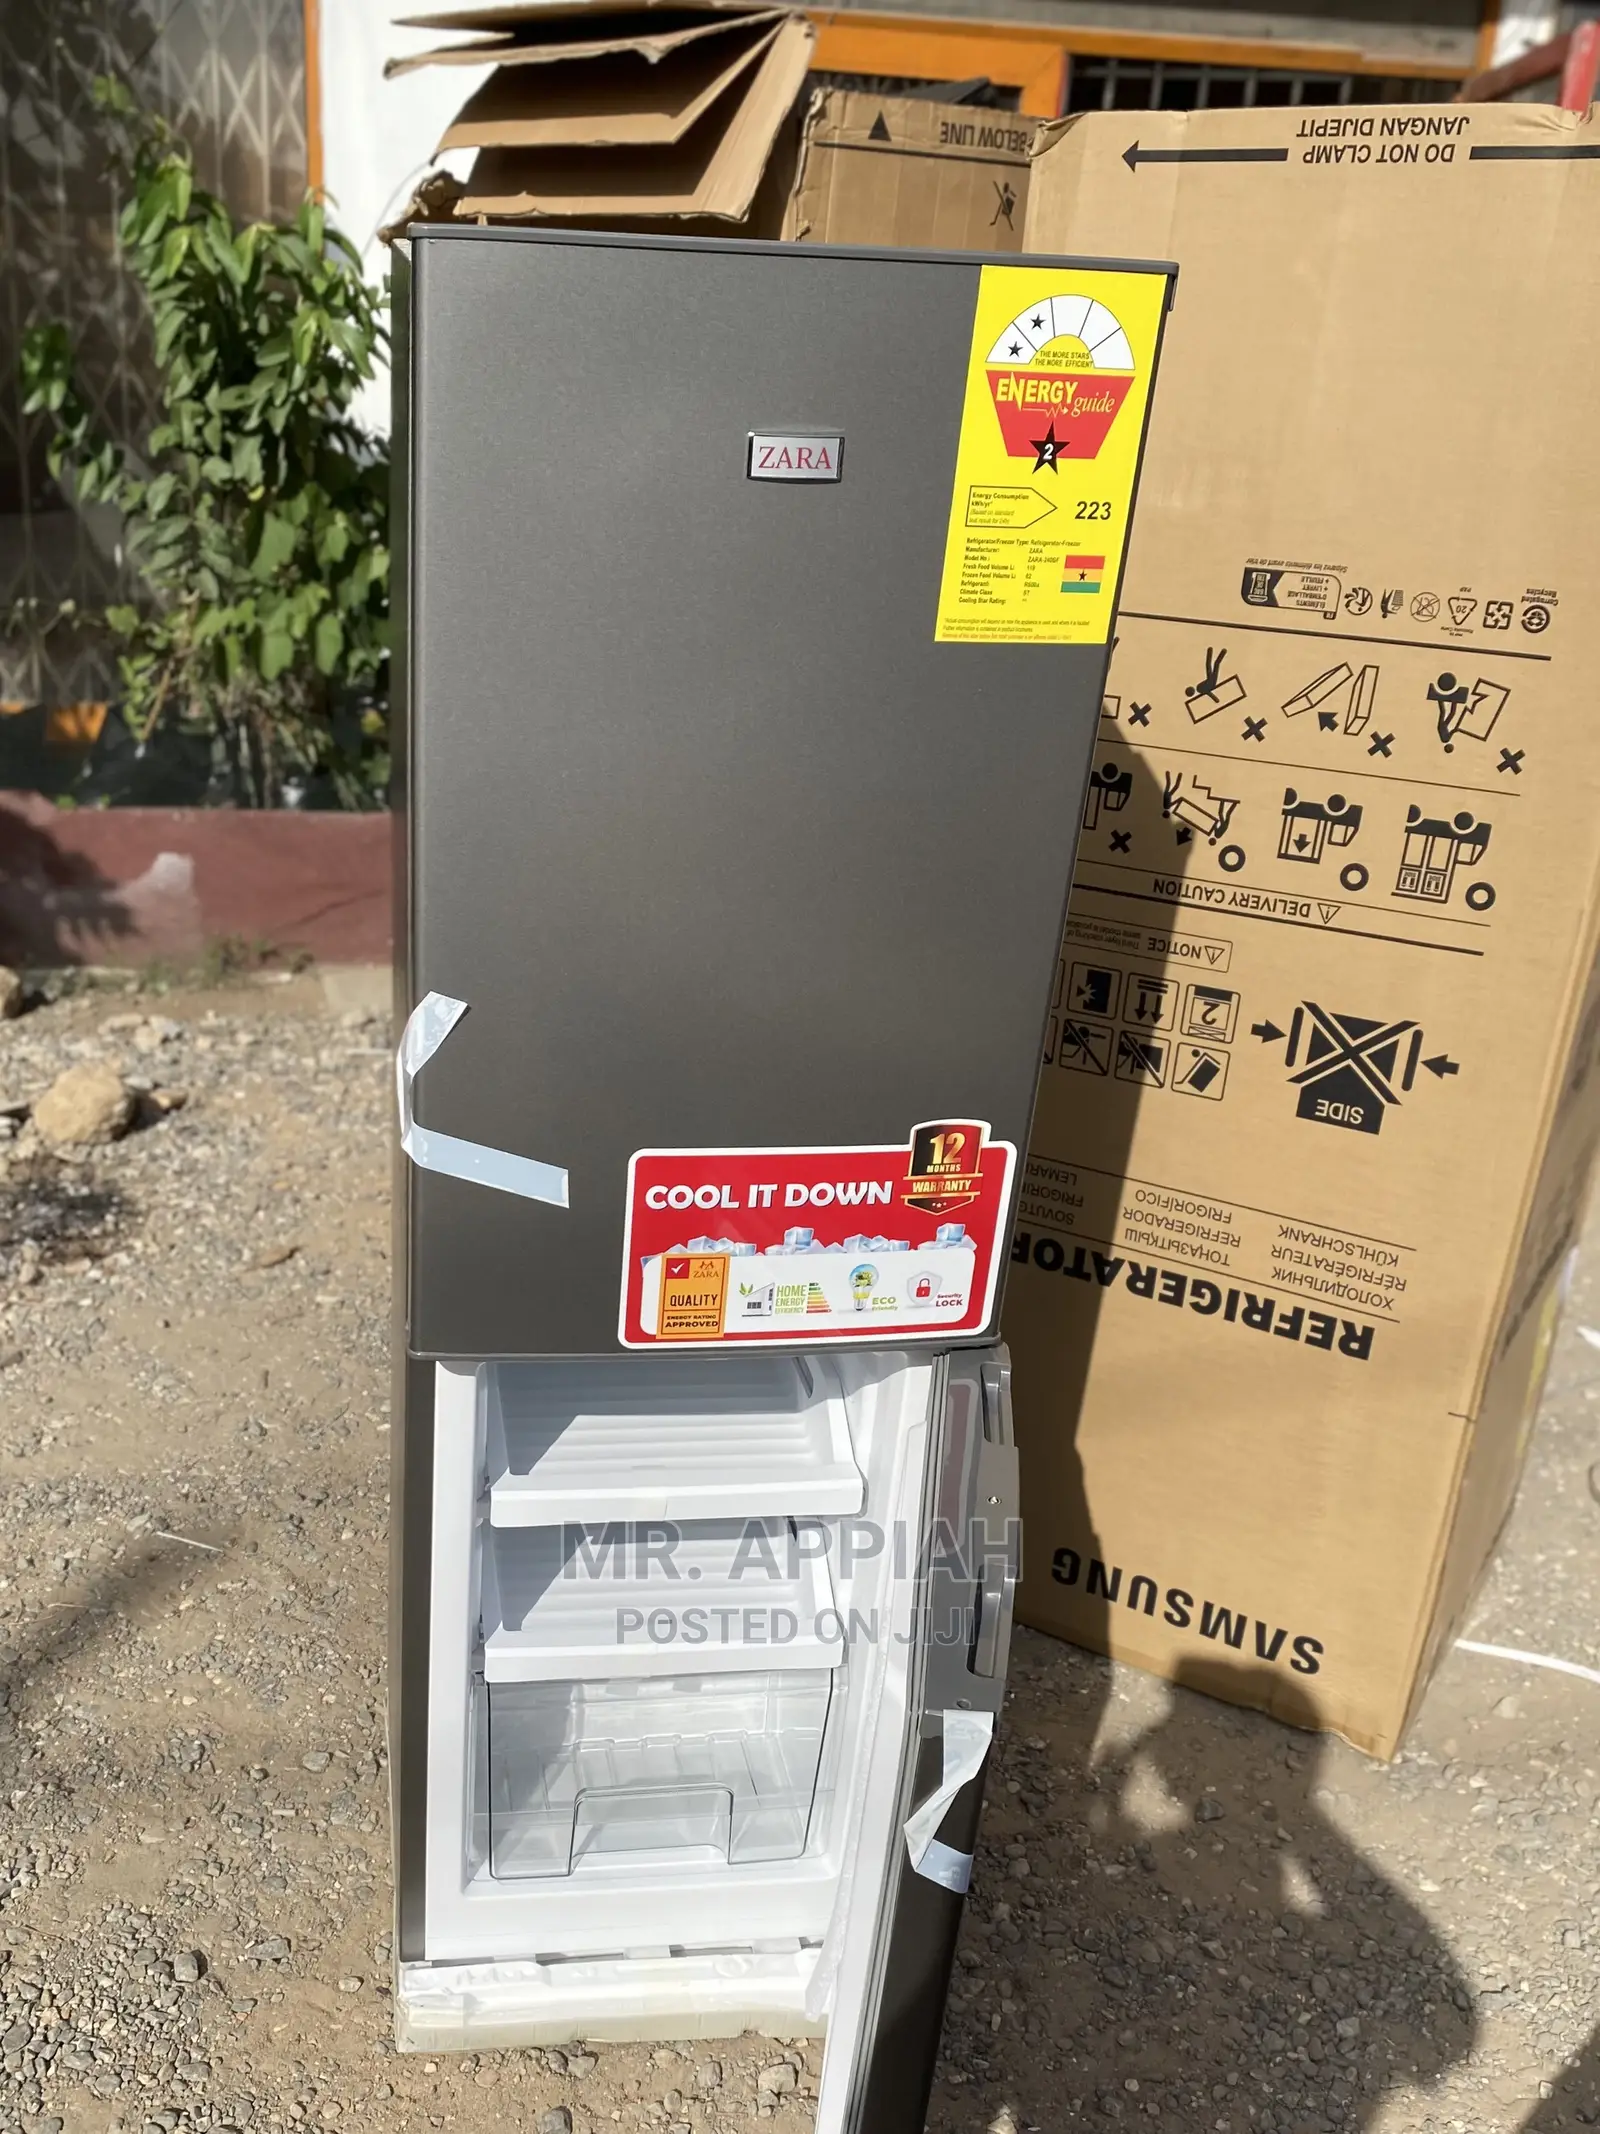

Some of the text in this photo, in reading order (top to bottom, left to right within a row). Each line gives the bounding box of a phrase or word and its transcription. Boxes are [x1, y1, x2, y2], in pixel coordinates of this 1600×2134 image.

[940, 122, 1027, 152] BELOW LINE
[1297, 116, 1470, 138] JANGAN DIJEPIT
[1302, 142, 1454, 164] DO NOT CLAMP
[996, 372, 1078, 412] ENERGY
[1072, 391, 1115, 417] guide
[758, 446, 832, 469] ZARA
[1043, 443, 1053, 459] 2
[1075, 501, 1112, 520] 223
[1456, 605, 1467, 613] 20
[1154, 879, 1311, 918] DELIVERY CAUTION
[1147, 937, 1202, 959] NOTICE
[1201, 1002, 1218, 1024] 2
[1315, 1099, 1364, 1124] SIDE
[929, 1132, 965, 1164] 12
[926, 1164, 962, 1173] MONTHS
[645, 1181, 893, 1211] COOL IT DOWN
[912, 1179, 972, 1194] WARRANTY
[1135, 1189, 1232, 1224] FRIGORÍFICO
[1123, 1207, 1241, 1247] REFRIGERADOR
[693, 1270, 720, 1279] ZARA
[1271, 1244, 1407, 1292] RÉFRIGÉRATEUR
[777, 1284, 807, 1297] HOME
[1011, 1230, 1375, 1361] REFRIGERATOR
[1271, 1266, 1394, 1311] ХОЛОДИЛЬНИК
[670, 1294, 718, 1307] QUALITY
[775, 1297, 806, 1307] ENERGY
[872, 1296, 896, 1305] ECO
[936, 1299, 963, 1307] LOCK
[665, 1320, 719, 1328] APPROVED
[1051, 1547, 1325, 1675] SAMSUNG
